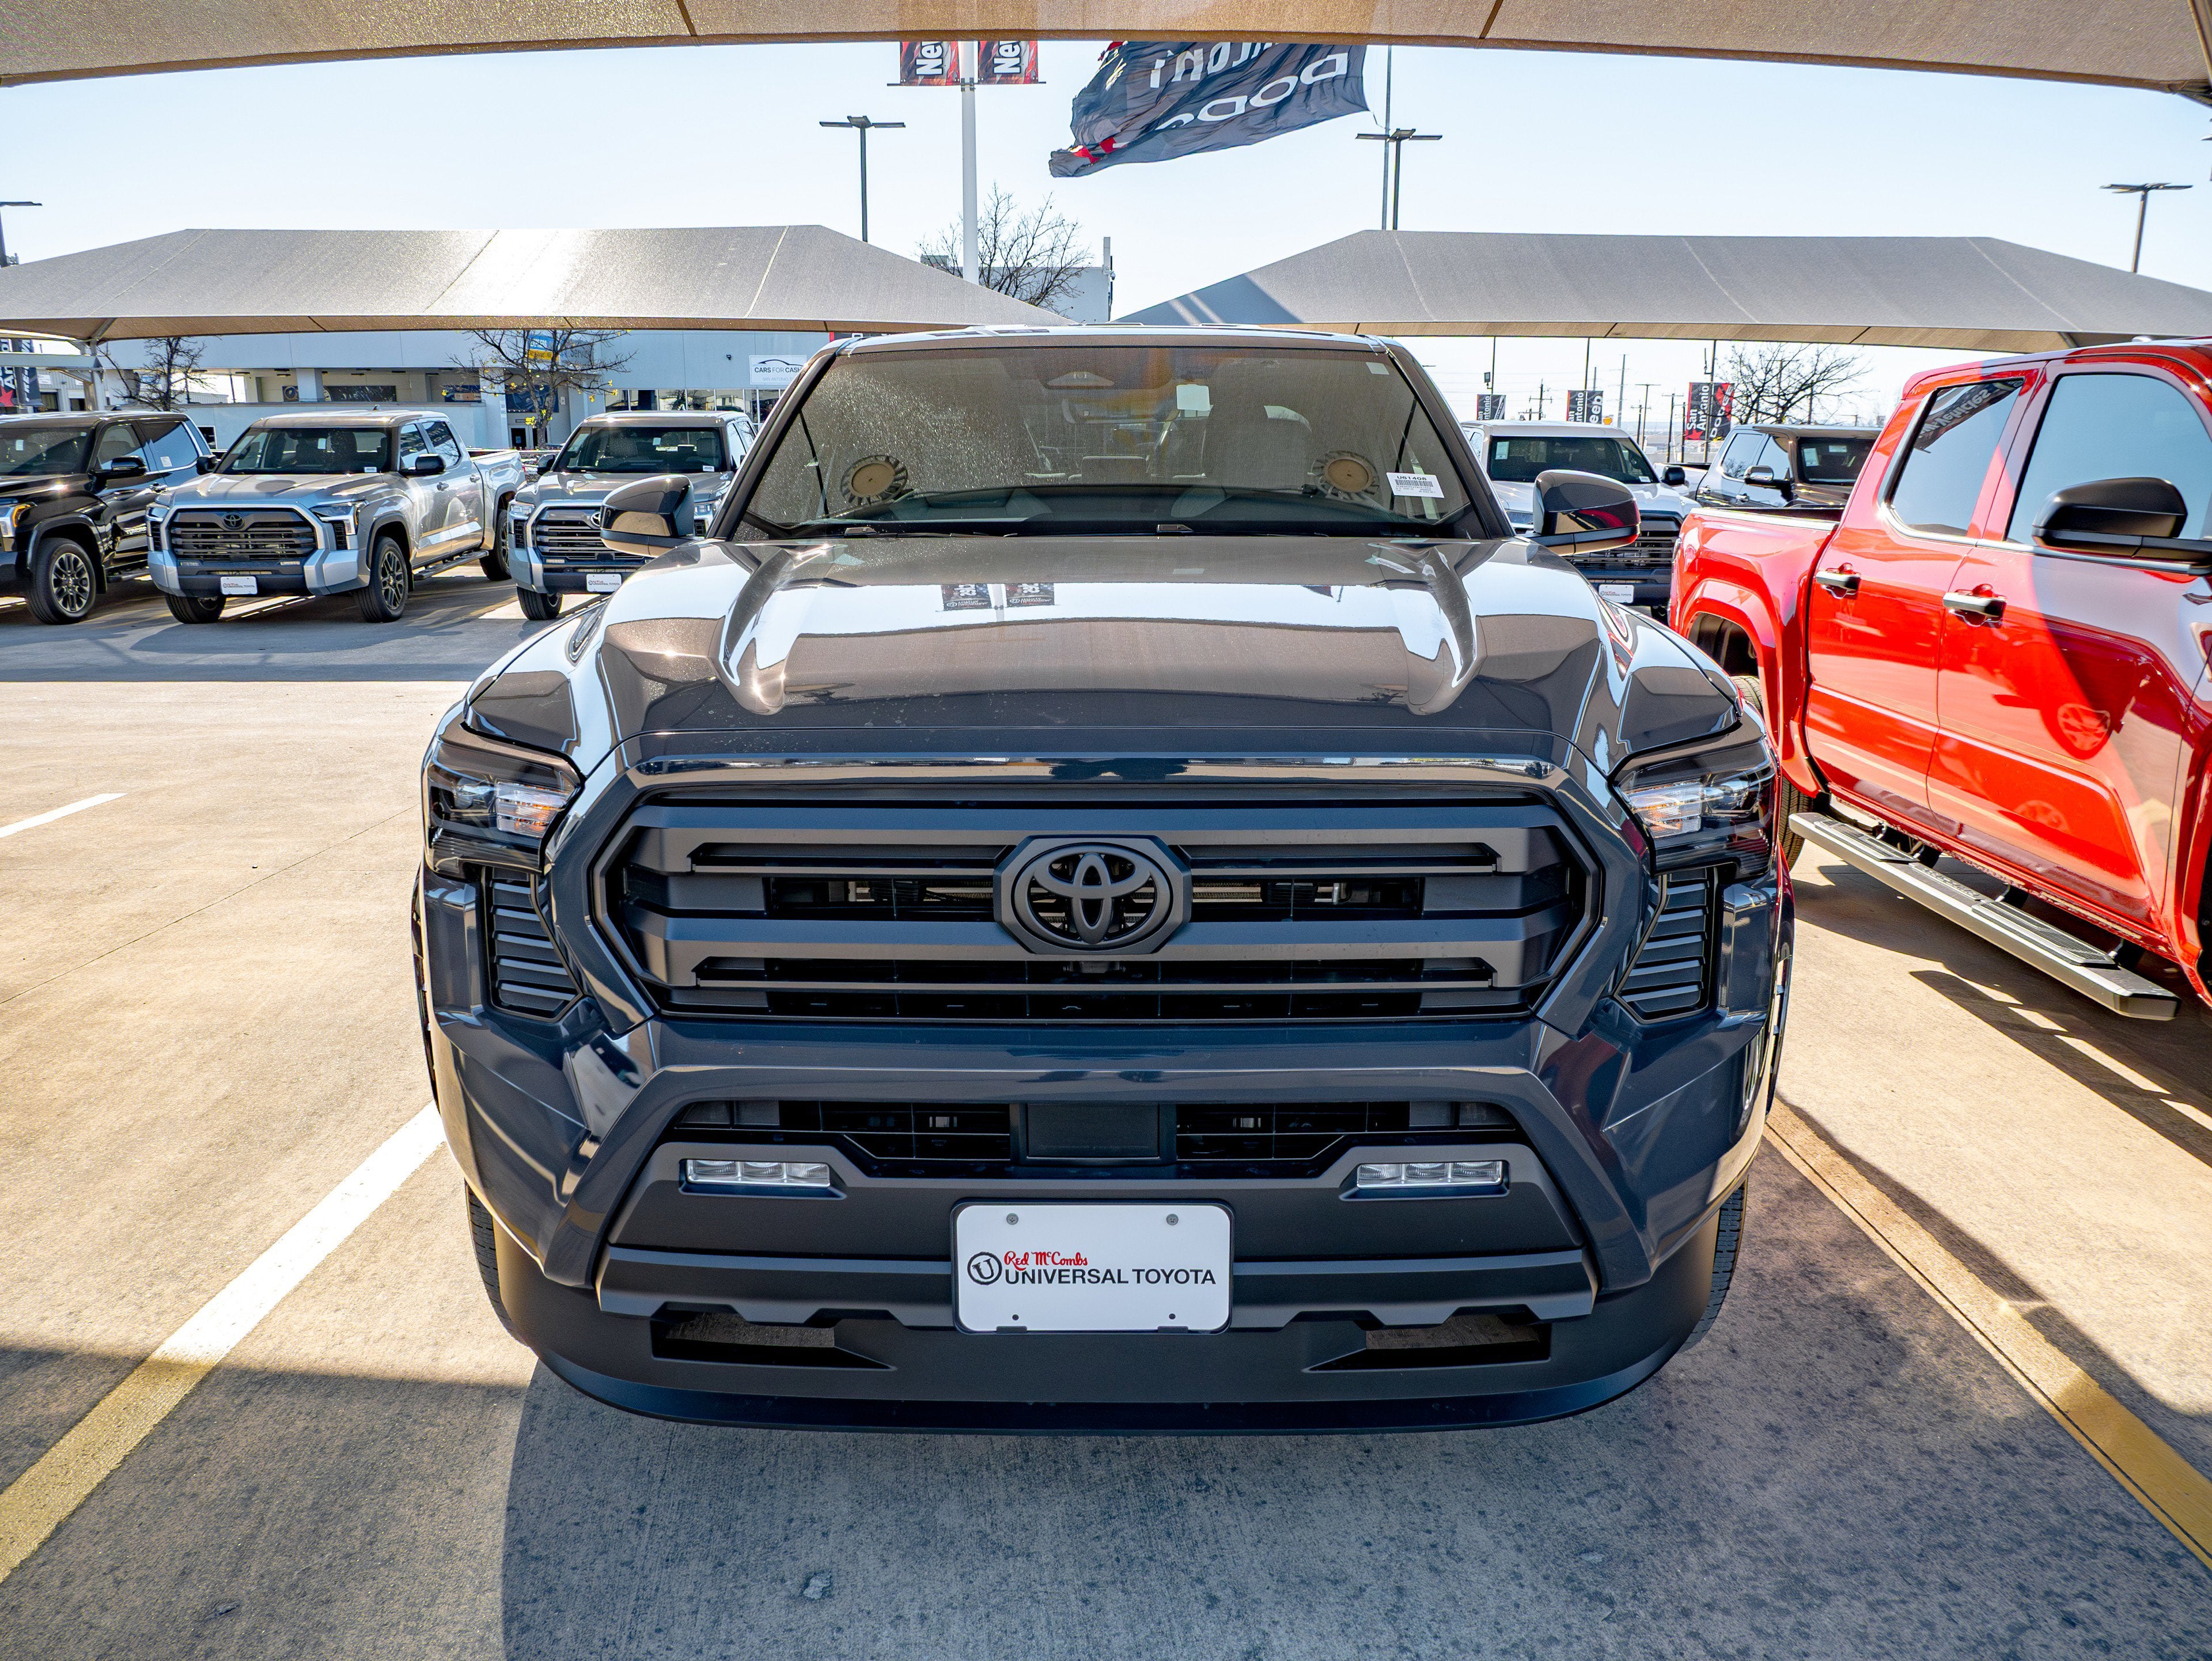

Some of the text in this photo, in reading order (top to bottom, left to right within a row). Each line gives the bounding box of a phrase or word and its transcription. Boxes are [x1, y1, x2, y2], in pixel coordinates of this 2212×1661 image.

[916, 41, 943, 75] Ne
[994, 41, 1021, 74] Ne
[1575, 392, 1584, 422] ntonio
[1589, 395, 1603, 423] eep
[1687, 409, 1697, 430] San
[1696, 385, 1709, 431] Antonio
[1004, 1251, 1088, 1271] Red McCombs
[1006, 1269, 1216, 1284] UNIVERSAL TOYOTA
